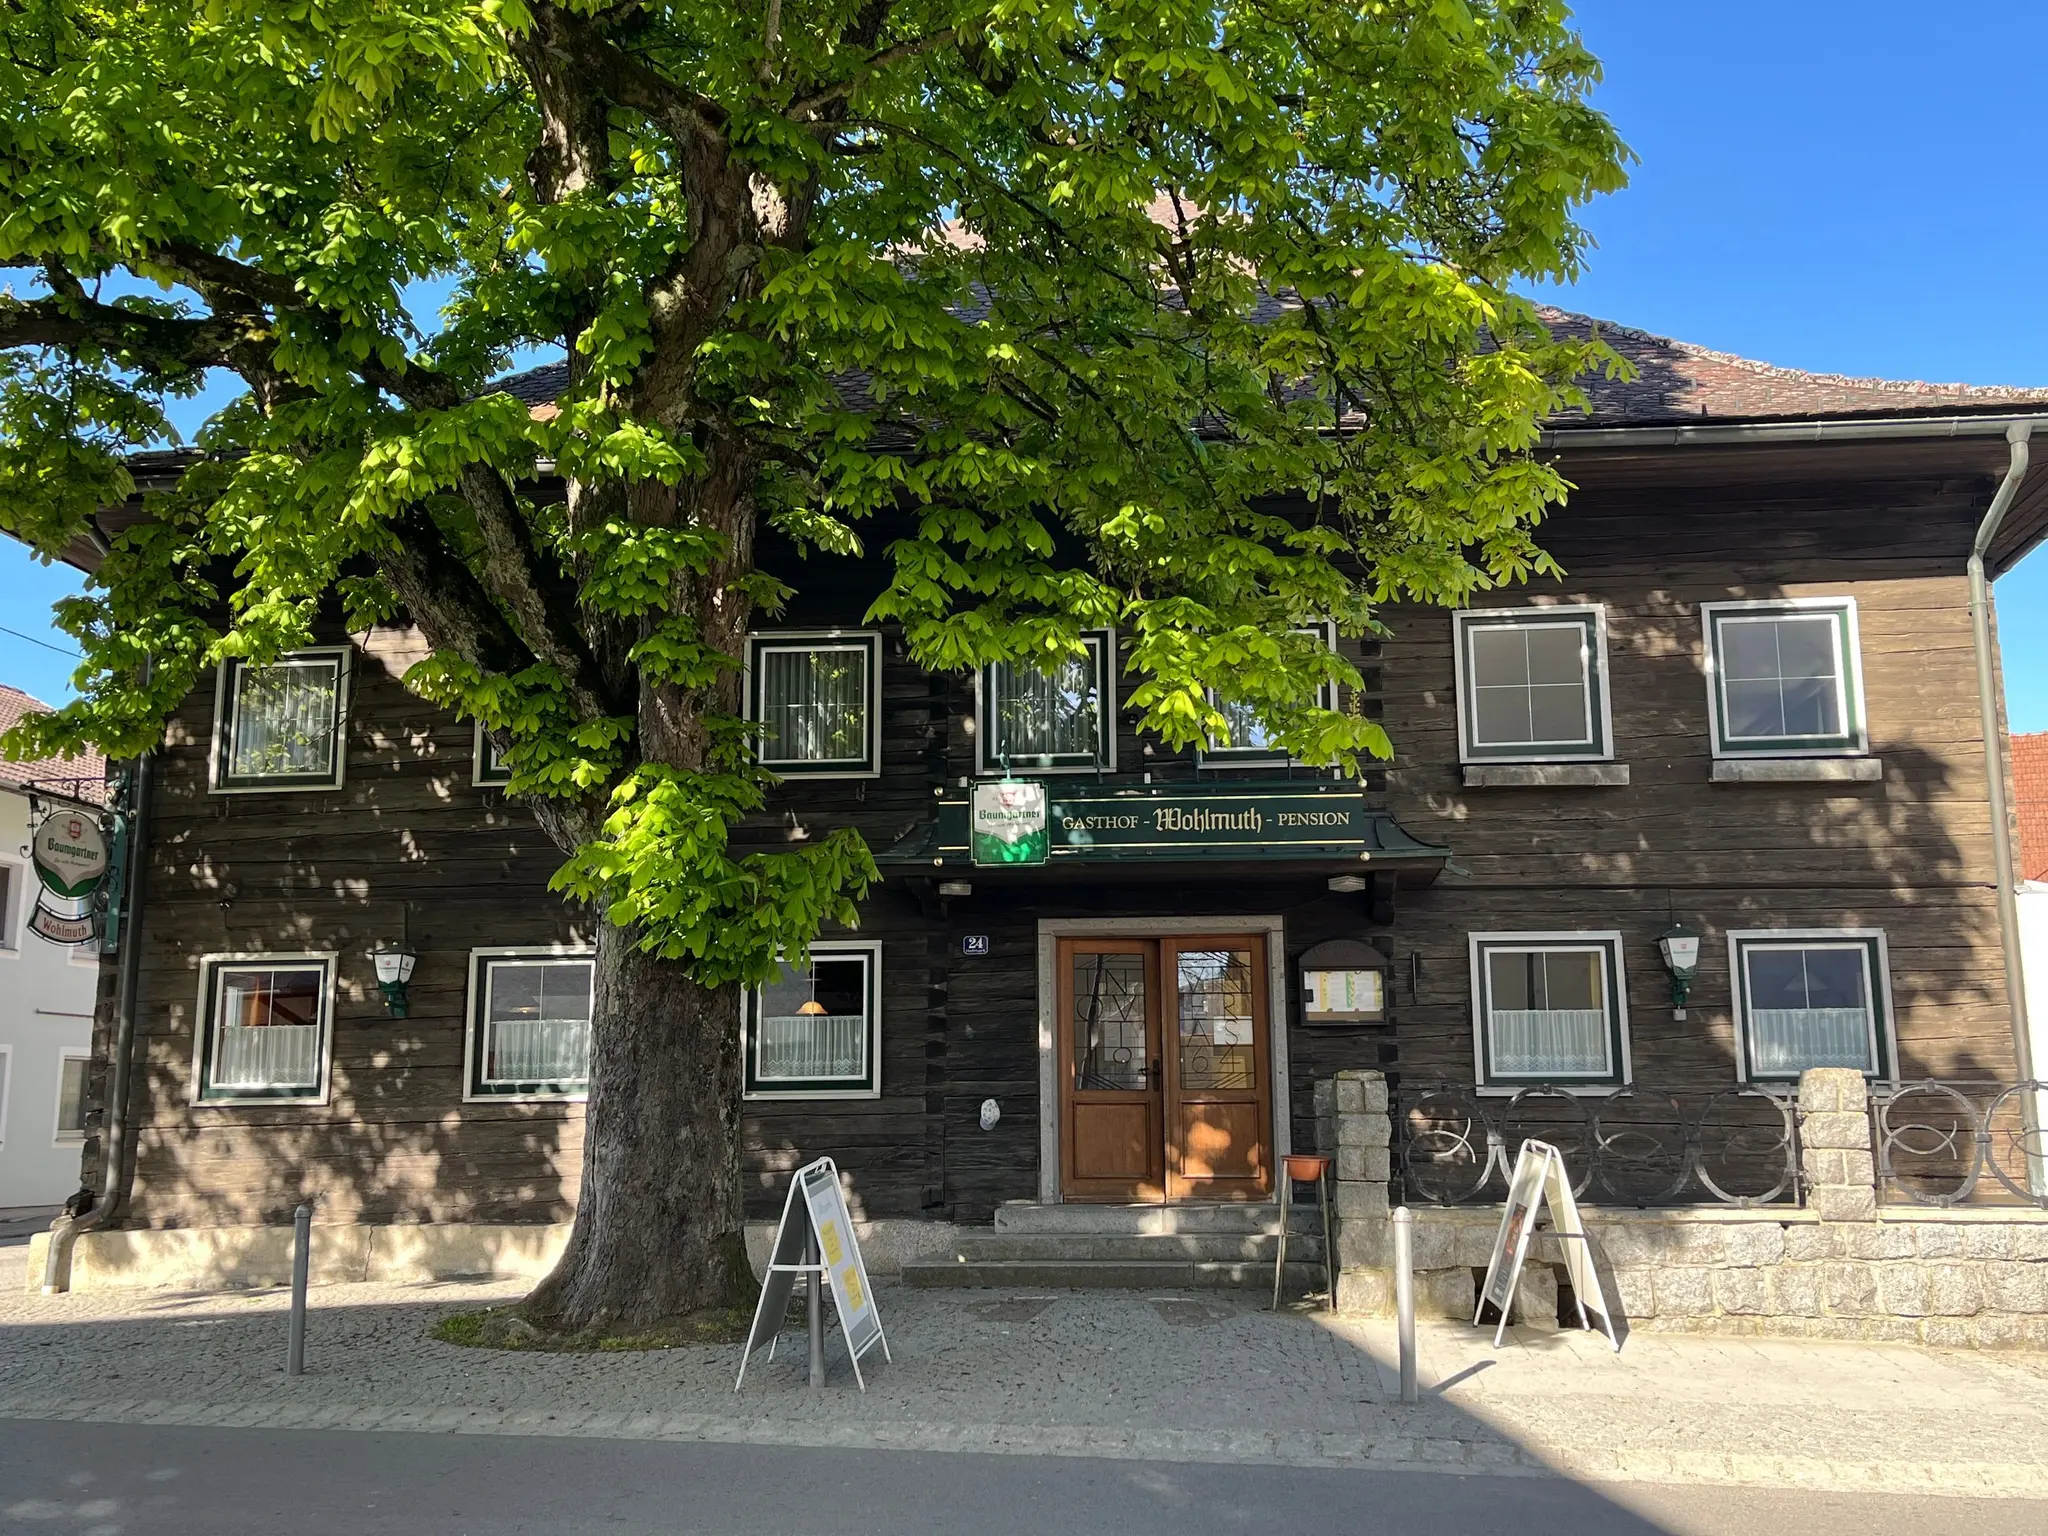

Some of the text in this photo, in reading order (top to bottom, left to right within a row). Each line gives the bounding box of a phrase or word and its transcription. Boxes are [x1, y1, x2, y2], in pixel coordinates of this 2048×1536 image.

[1062, 815, 1139, 830] GASTHOF
[1153, 806, 1262, 834] Wohlmuth
[1278, 812, 1351, 826] PENSION
[48, 837, 99, 861] Baumgartner
[43, 917, 87, 938] Wohlmuth
[968, 936, 984, 949] 24
